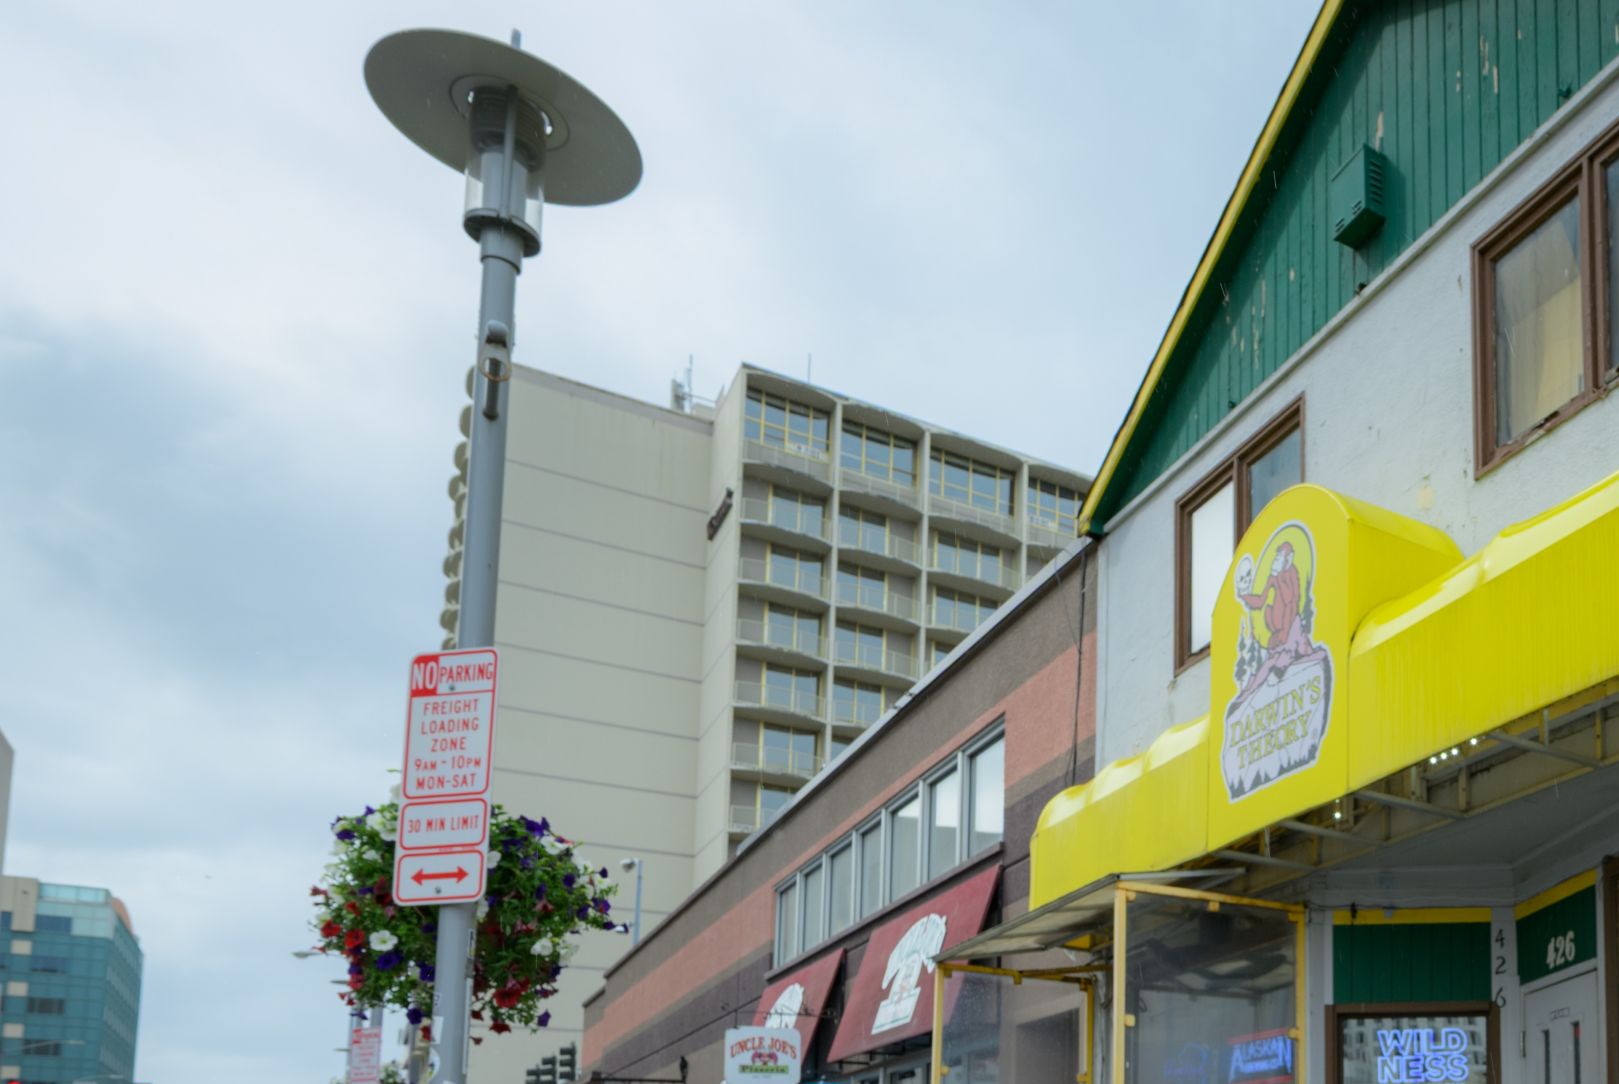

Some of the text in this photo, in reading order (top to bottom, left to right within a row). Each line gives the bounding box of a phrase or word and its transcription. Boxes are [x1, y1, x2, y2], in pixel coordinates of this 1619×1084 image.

[412, 663, 493, 690] NO PARKING
[424, 699, 479, 716] FREIGHT
[1230, 675, 1321, 748] DARWIN'S
[421, 717, 479, 735] LOADING
[431, 737, 467, 752] ZONE
[1237, 710, 1312, 770] THEORY
[414, 758, 437, 771] 9AM
[451, 755, 481, 769] 10PM
[416, 773, 477, 790] MON-SAT
[408, 815, 479, 833] 30 MIN LIMIT
[1546, 930, 1576, 970] 426
[730, 1036, 797, 1059] UNCLE JOE'S
[1377, 1027, 1468, 1057] WILD
[1228, 1035, 1292, 1082] ALASKAN
[1377, 1054, 1470, 1084] NESS
